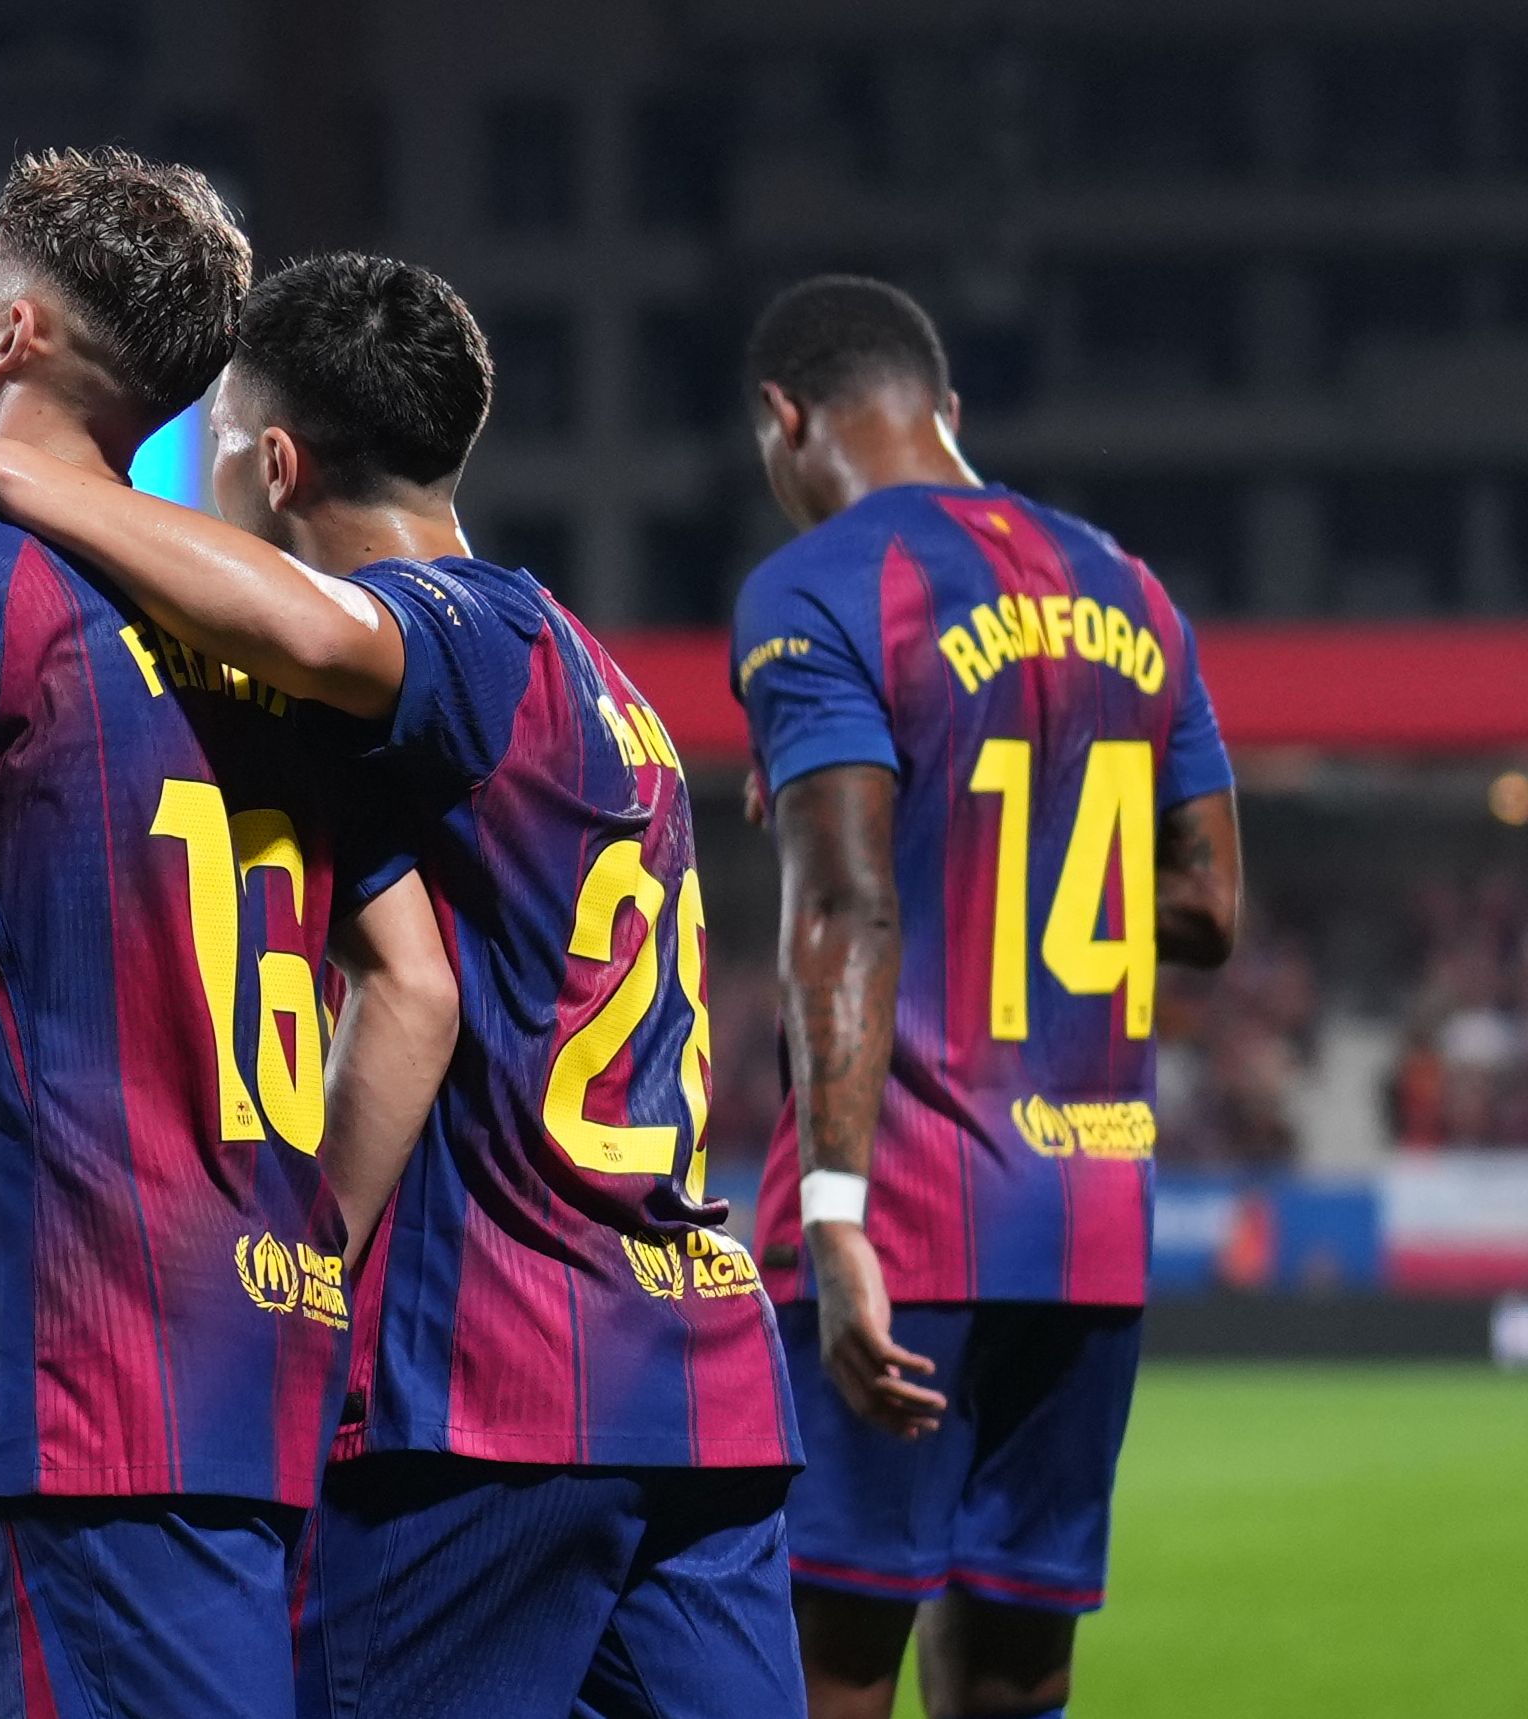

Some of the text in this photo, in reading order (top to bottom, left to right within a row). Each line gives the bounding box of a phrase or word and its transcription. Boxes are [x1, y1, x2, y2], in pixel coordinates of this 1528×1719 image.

[148, 778, 326, 1157] 16
[970, 739, 1158, 1040] 14
[693, 1253, 759, 1288] ACNU
